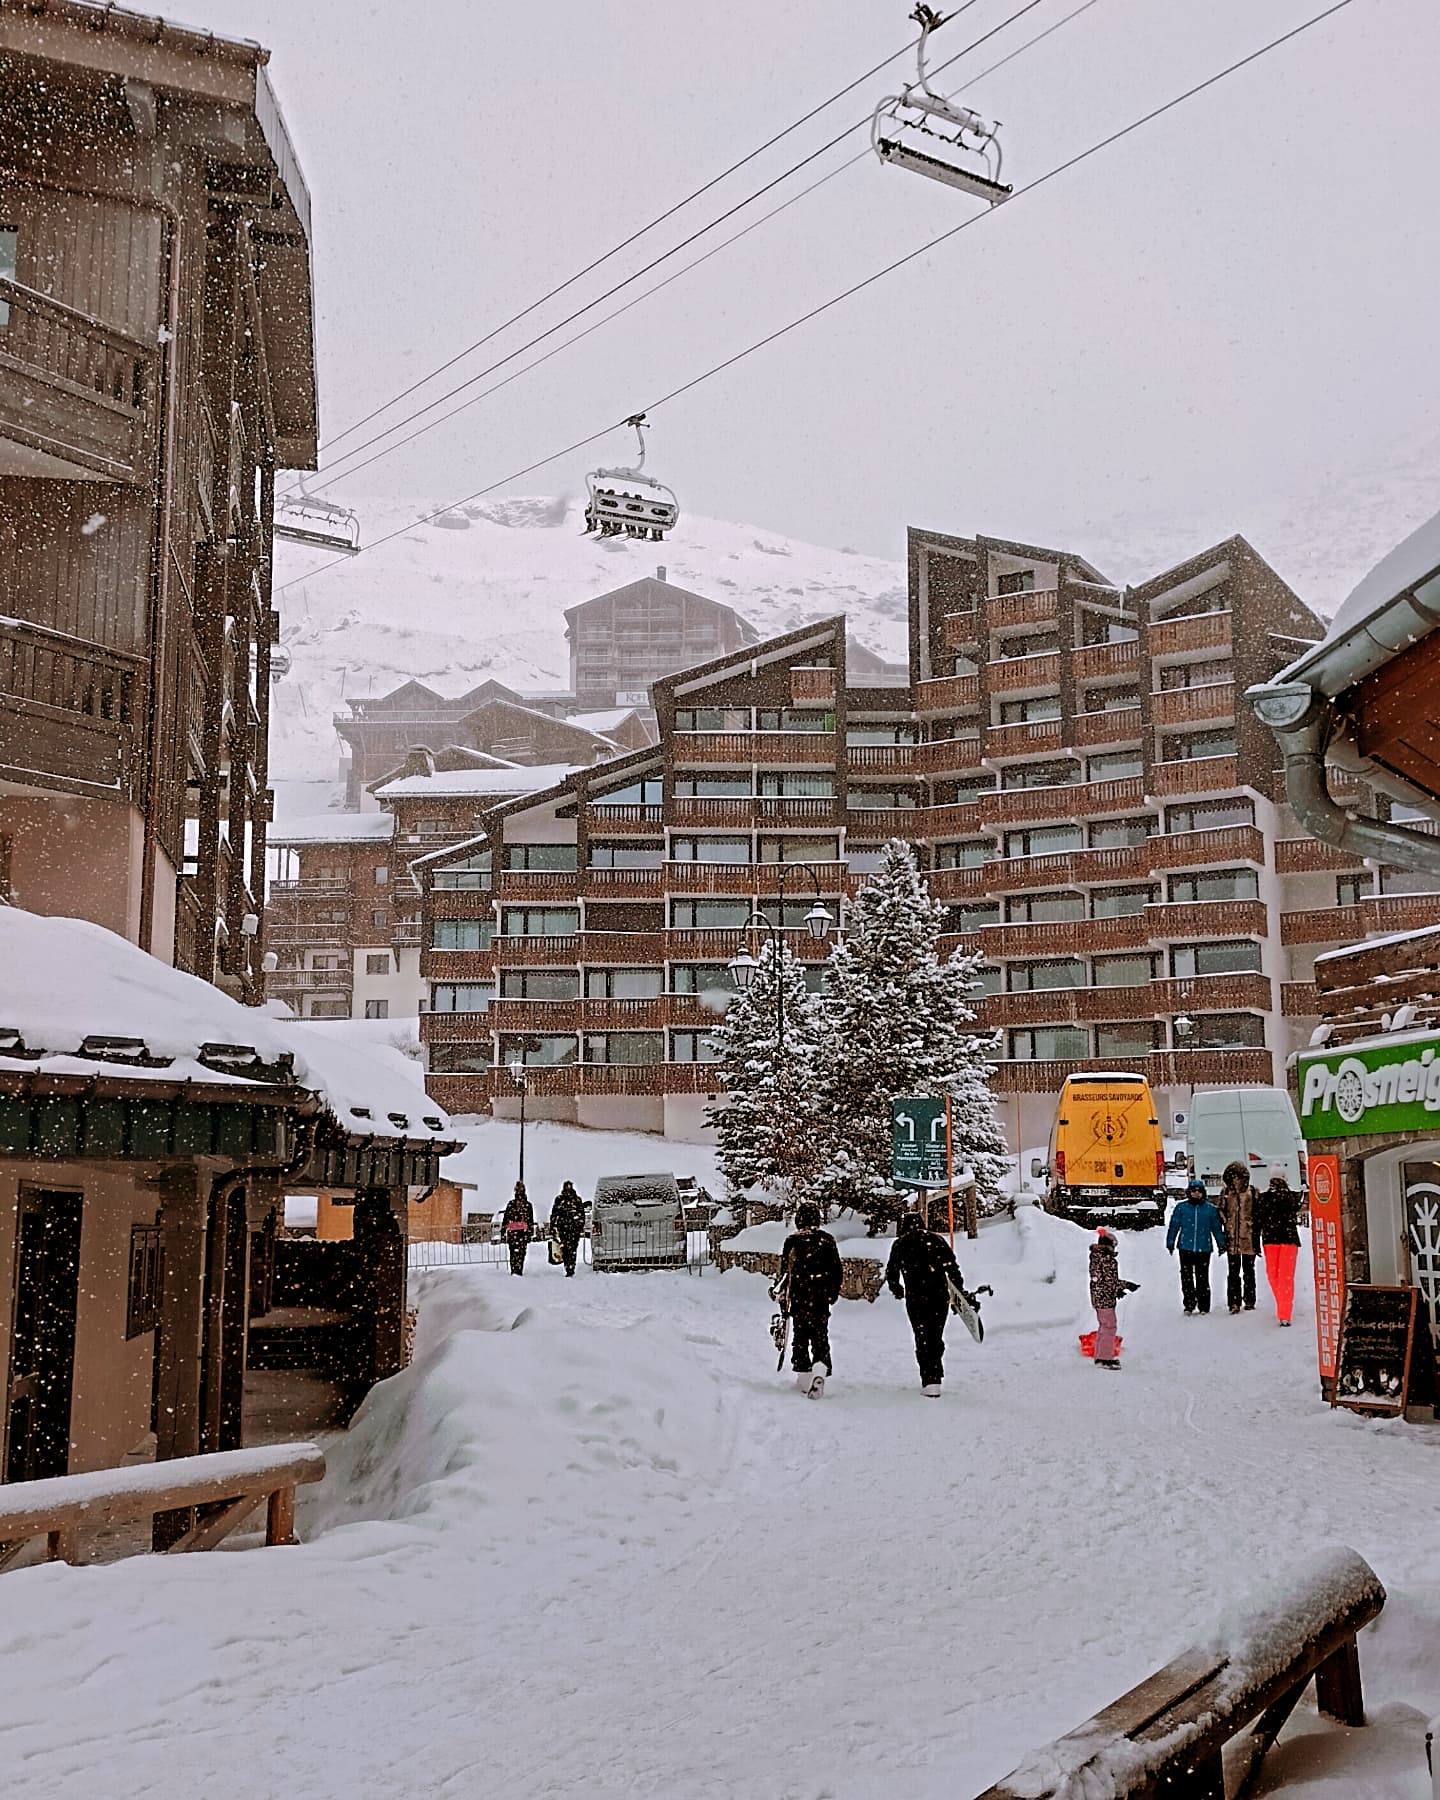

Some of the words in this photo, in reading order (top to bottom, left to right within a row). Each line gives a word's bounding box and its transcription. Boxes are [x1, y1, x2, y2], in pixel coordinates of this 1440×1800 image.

[1072, 1093, 1108, 1102] BRASSEURS
[1109, 1093, 1143, 1102] SAVOYARDS
[1315, 1217, 1331, 1368] SPECIALISTES
